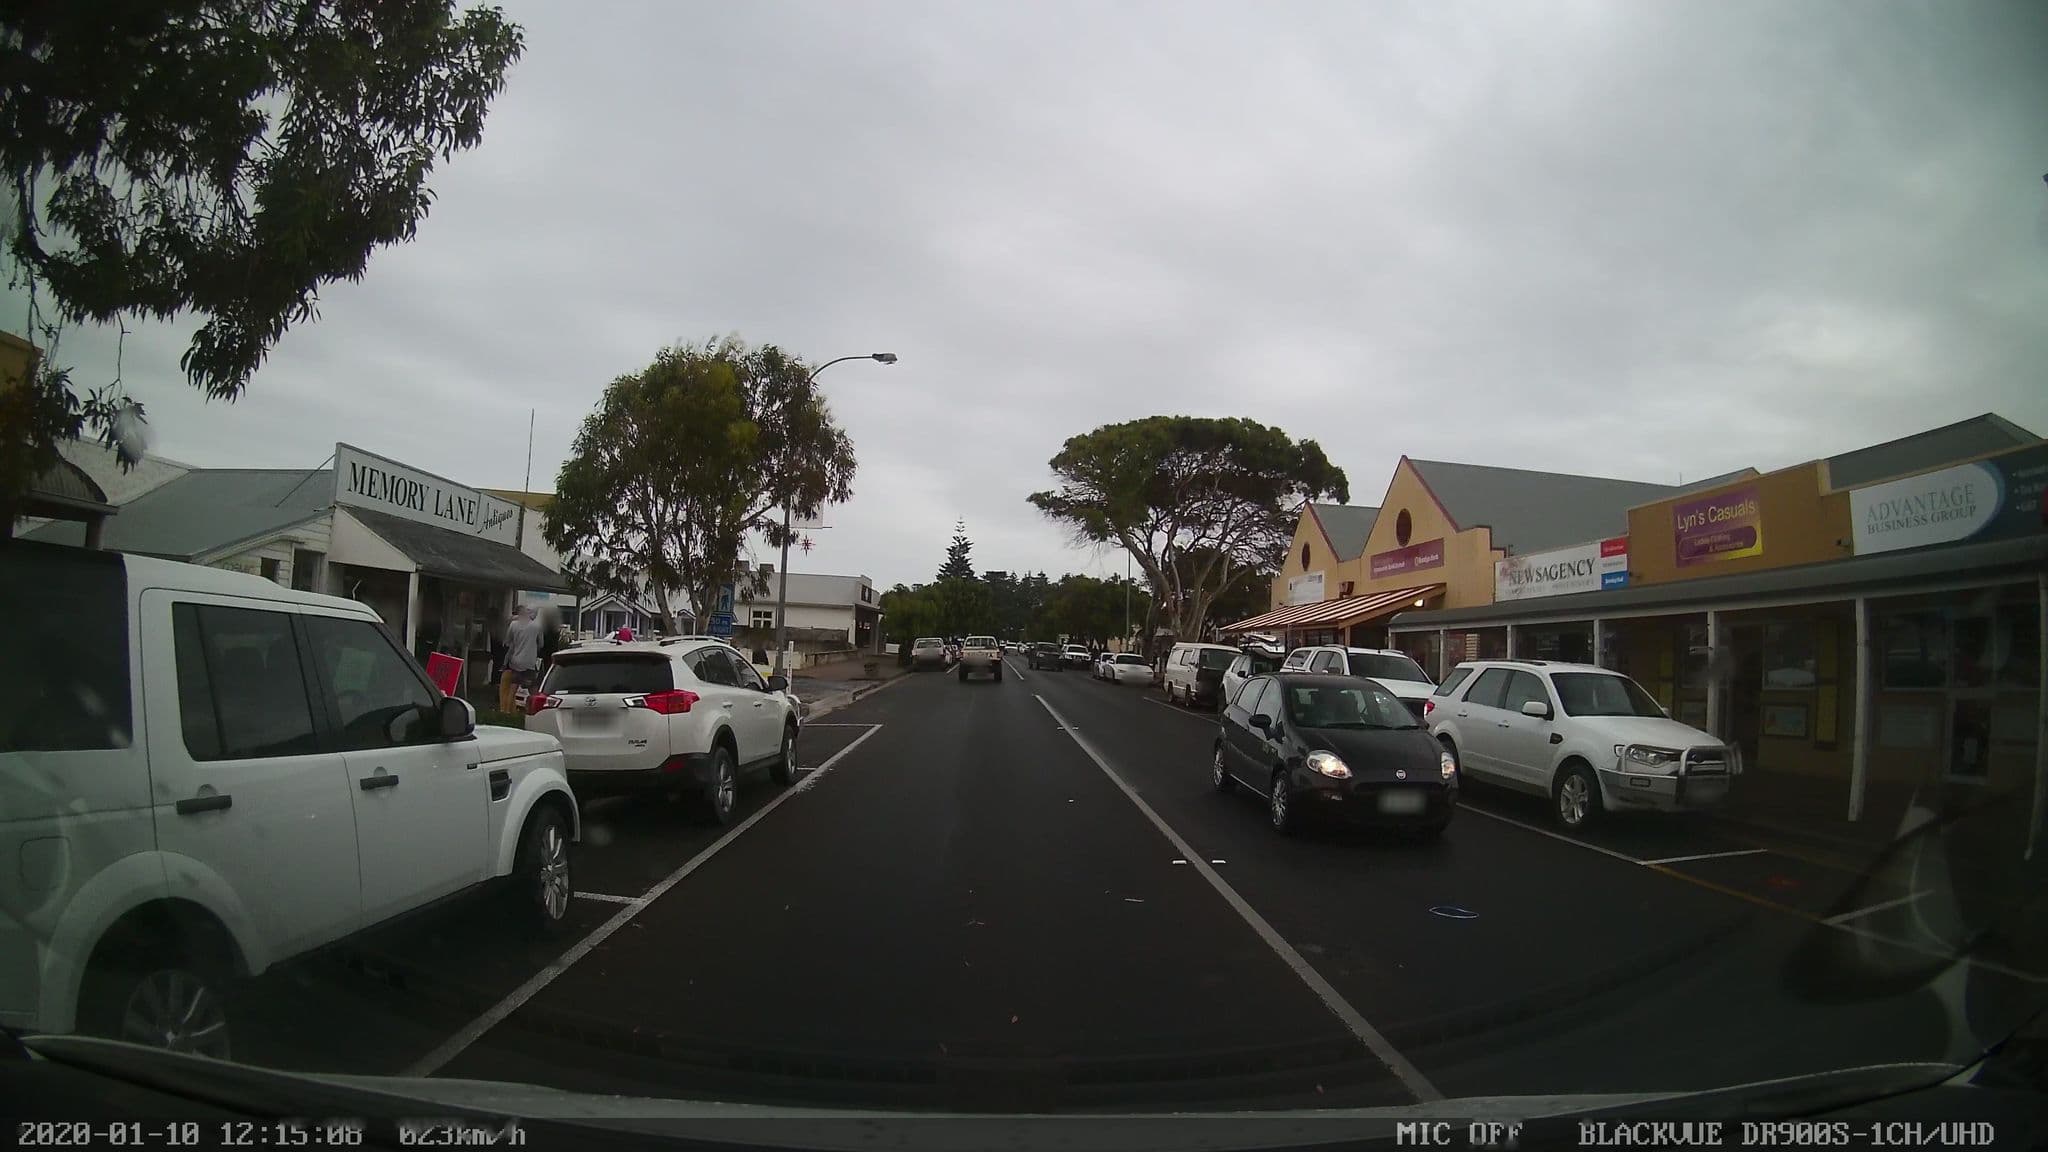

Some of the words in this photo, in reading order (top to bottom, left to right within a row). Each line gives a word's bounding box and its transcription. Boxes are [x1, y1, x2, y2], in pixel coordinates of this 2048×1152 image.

[347, 461, 430, 512] MEMORY
[433, 489, 477, 526] LANE
[477, 501, 514, 534] Antiques
[1866, 484, 1976, 523] ADVANTAGE
[1677, 510, 1705, 533] Lyn's
[1708, 498, 1756, 523] Casuals
[1867, 511, 1928, 535] BUSINESS
[1930, 504, 1977, 525] GROUP
[1509, 558, 1595, 586] NEWSAGENCY
